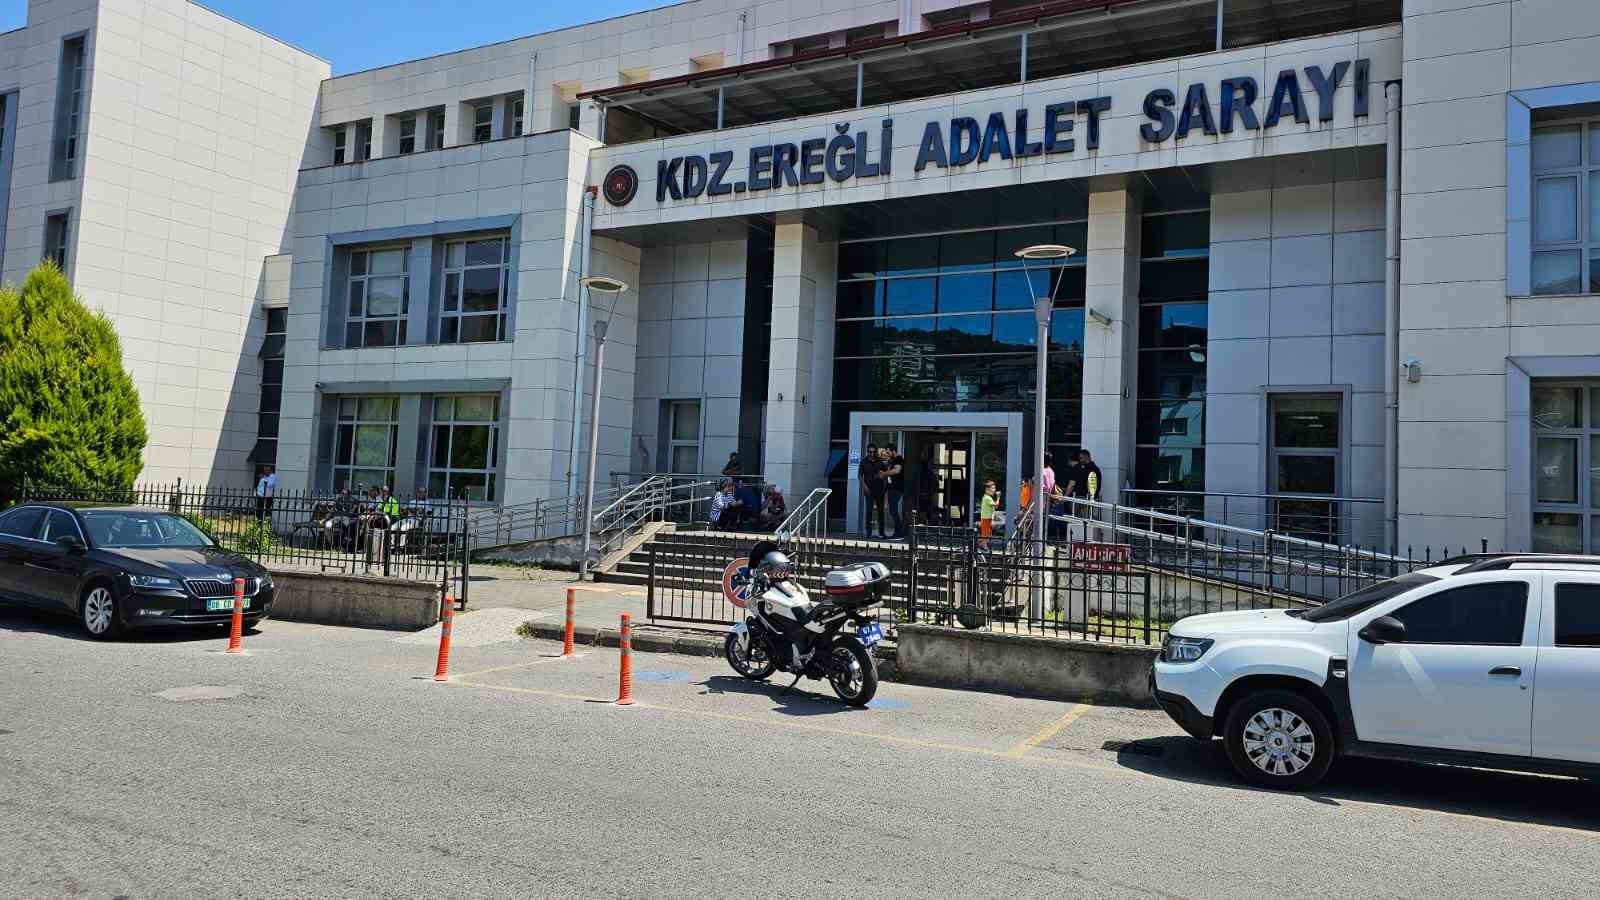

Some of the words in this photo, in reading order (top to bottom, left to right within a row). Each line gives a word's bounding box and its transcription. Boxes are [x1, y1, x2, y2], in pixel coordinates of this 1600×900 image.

[656, 119, 892, 202] KDZ.EREĞLİ
[914, 96, 1112, 172] ADALET
[1139, 58, 1369, 143] SARAYI
